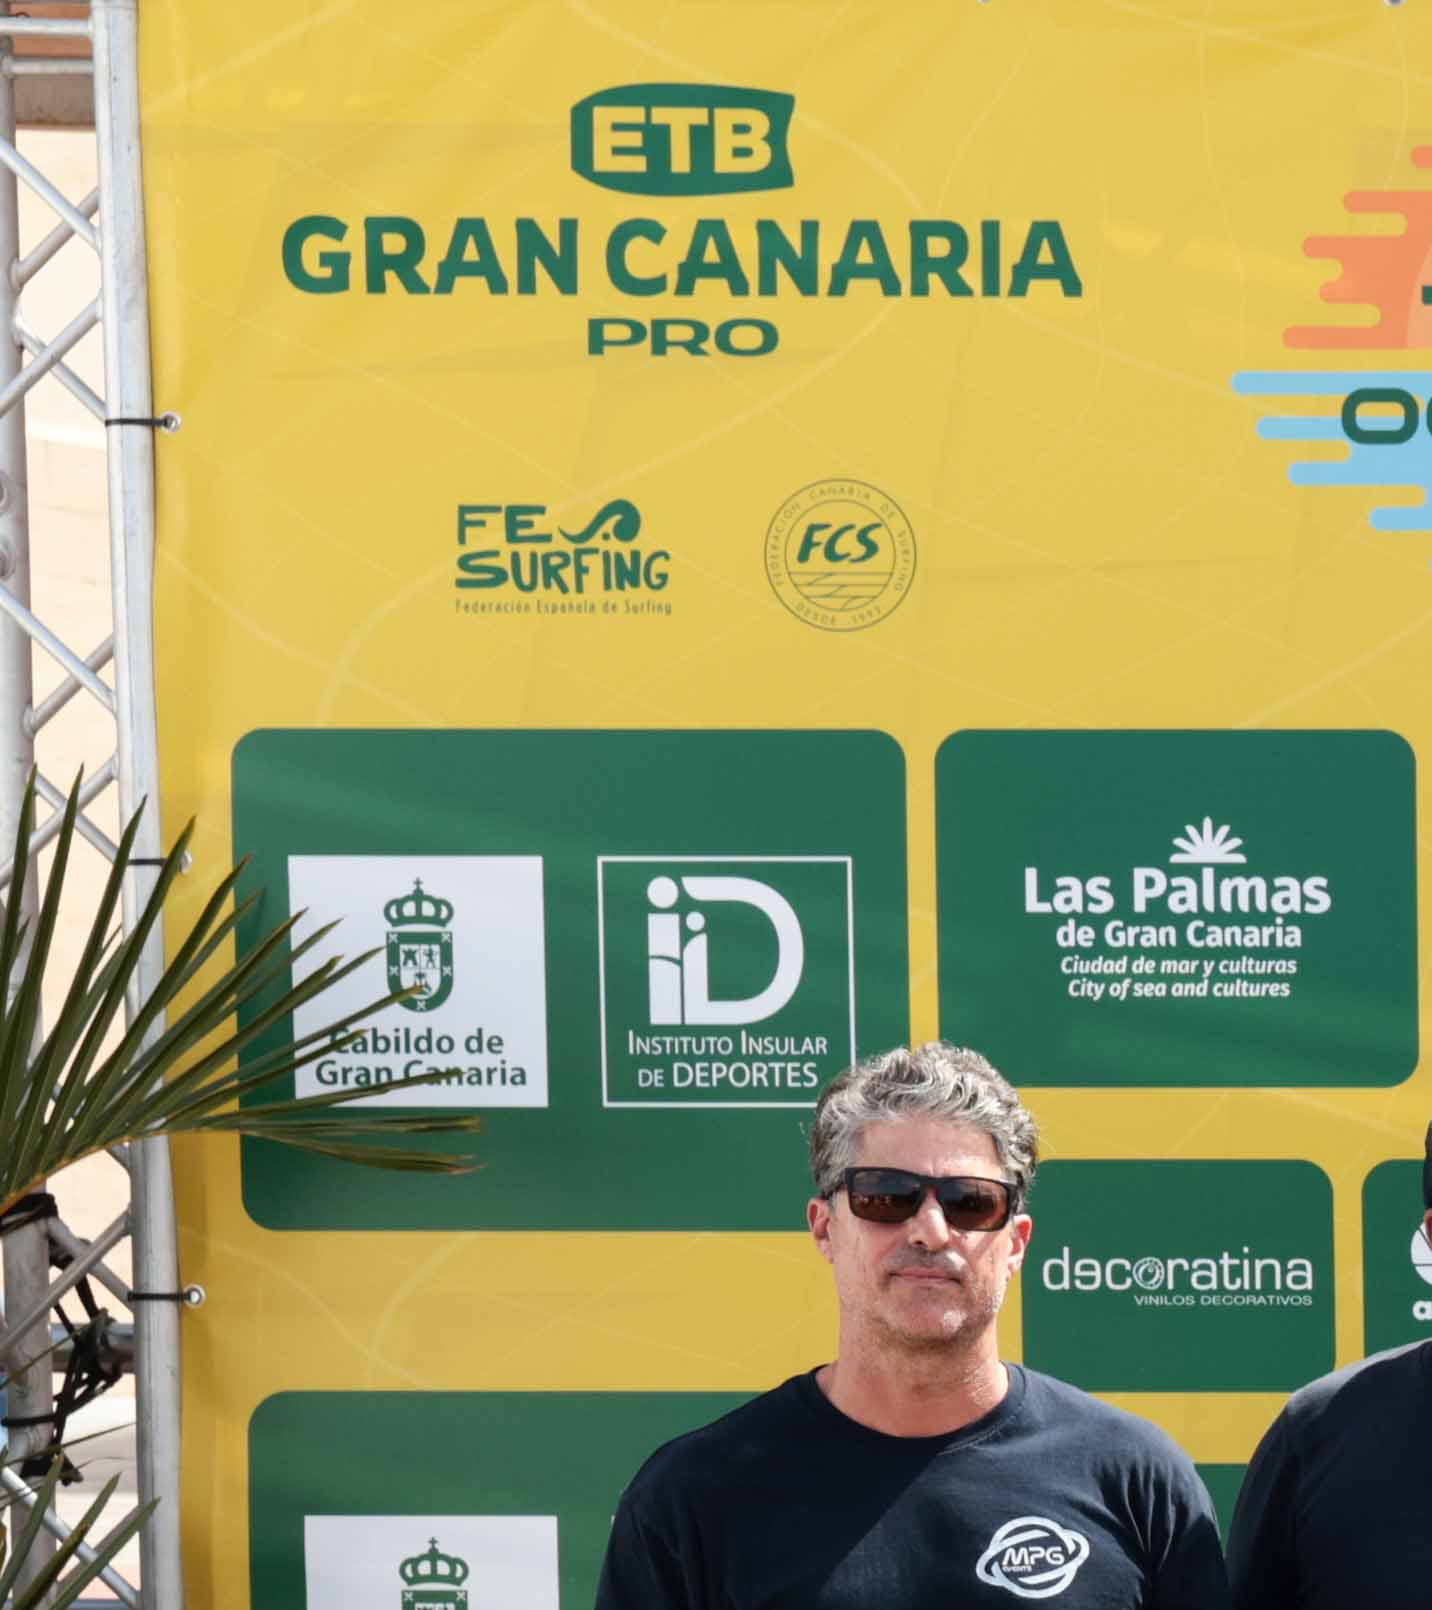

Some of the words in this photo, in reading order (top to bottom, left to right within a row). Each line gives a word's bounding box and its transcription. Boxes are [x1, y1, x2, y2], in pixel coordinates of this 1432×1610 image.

[592, 107, 772, 173] ETB
[281, 215, 579, 296] GRAN
[605, 218, 1081, 298] CANARIA
[588, 319, 779, 356] PRO
[797, 522, 879, 564] FCS
[456, 548, 670, 595] SURFING
[623, 600, 671, 616] Surfing
[1025, 867, 1114, 914] Las
[1135, 867, 1332, 914] Palmas
[1056, 919, 1095, 948] de
[1103, 919, 1177, 948] Gran
[1186, 919, 1302, 948] Canaria
[465, 1027, 503, 1055] de
[639, 1069, 664, 1087] DE
[673, 1062, 818, 1088] DEPORTES
[1134, 1295, 1196, 1306] VINILOS
[1201, 1295, 1312, 1306] DECORATIVOS
[1002, 1545, 1066, 1567] MPG
